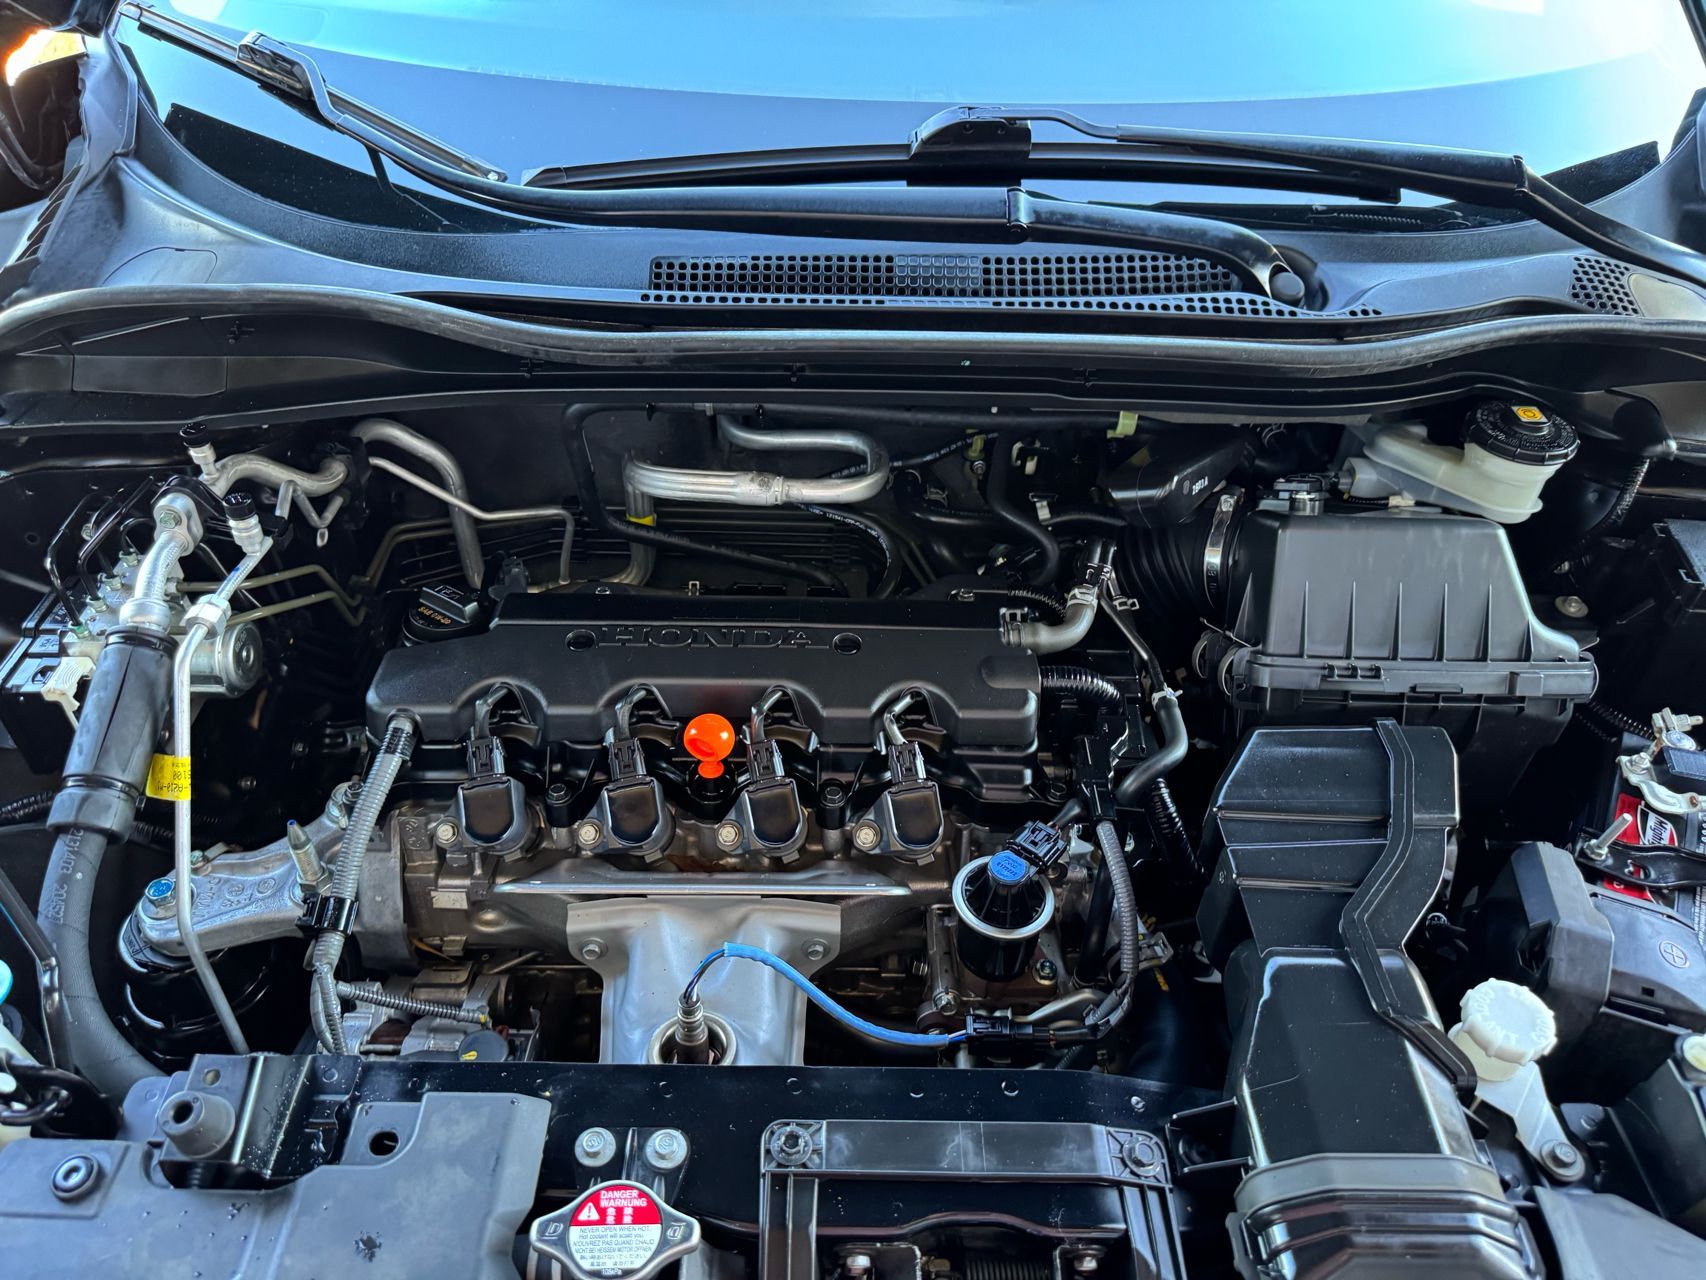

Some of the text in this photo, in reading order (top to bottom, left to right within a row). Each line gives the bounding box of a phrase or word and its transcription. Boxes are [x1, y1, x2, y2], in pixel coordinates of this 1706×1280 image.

[417, 606, 434, 617] SAE
[599, 627, 829, 649] HONDA
[601, 1190, 639, 1199] DANGER
[600, 1198, 647, 1207] WARNUNG
